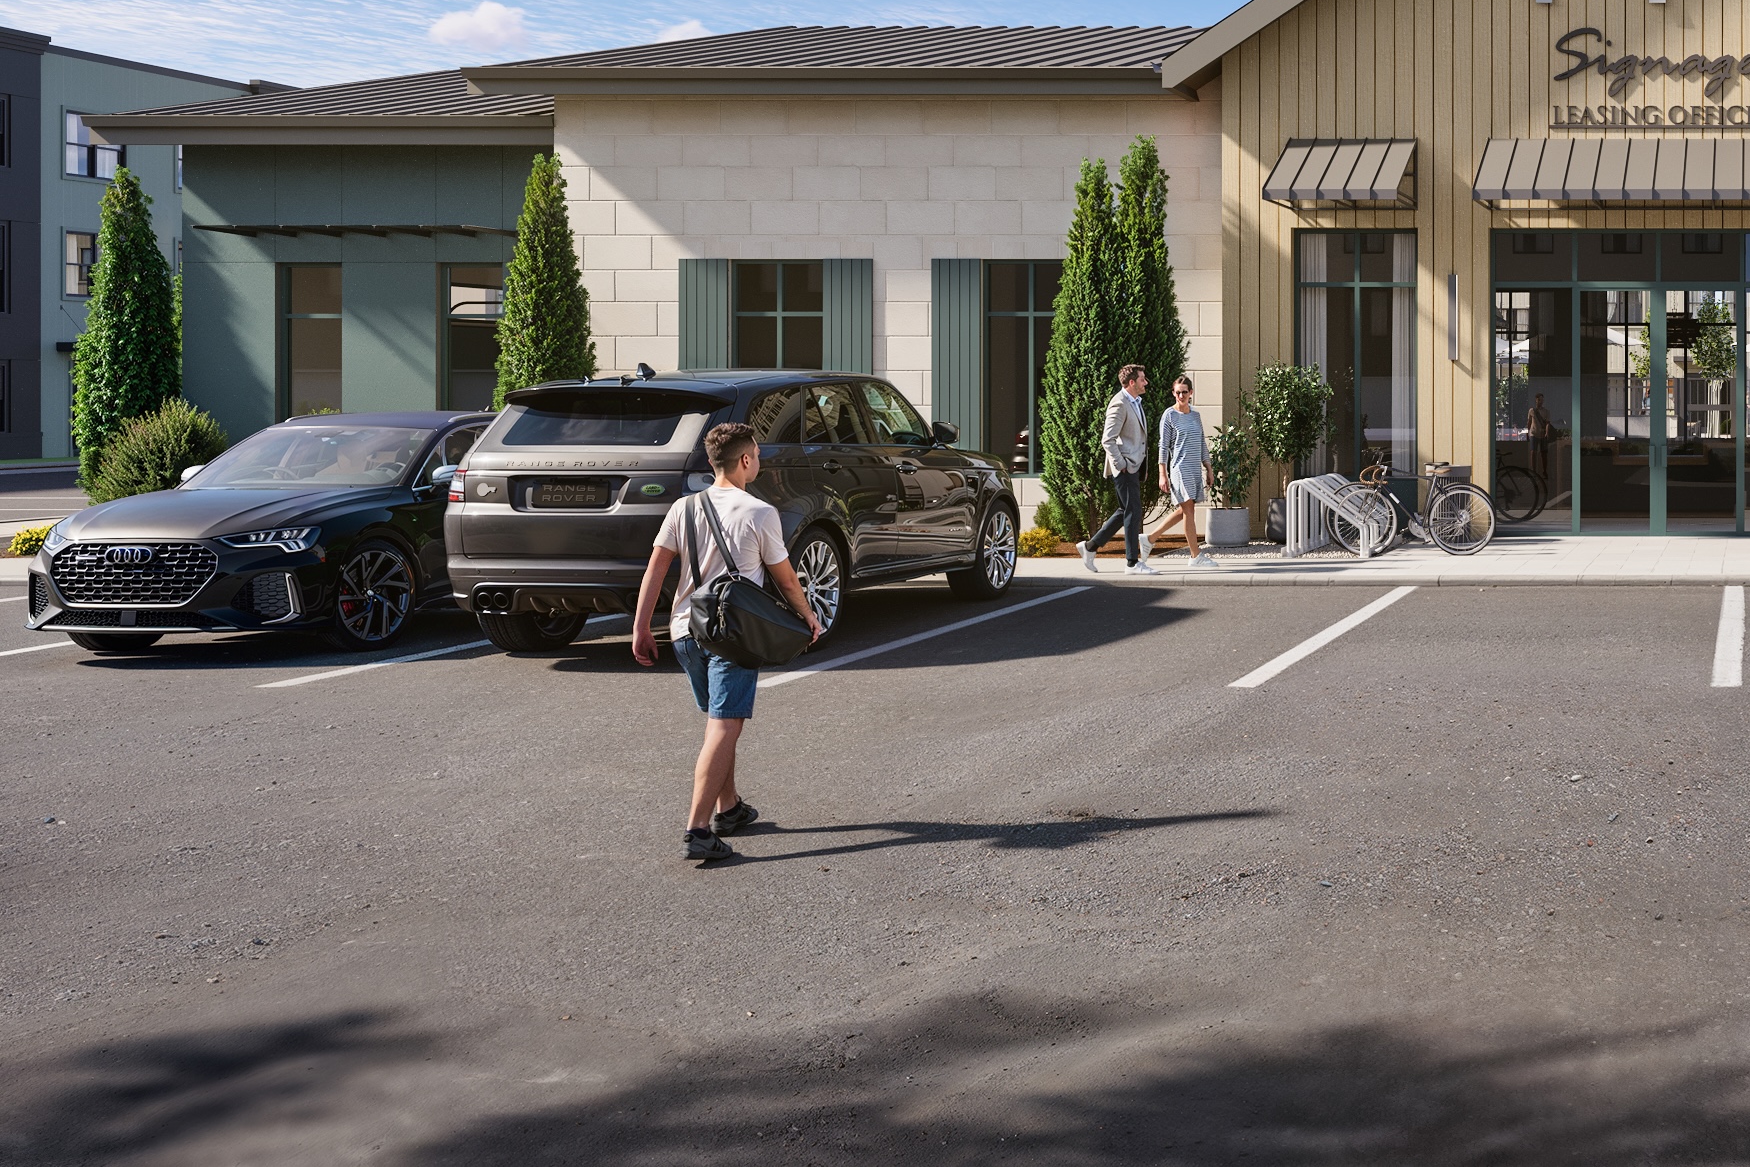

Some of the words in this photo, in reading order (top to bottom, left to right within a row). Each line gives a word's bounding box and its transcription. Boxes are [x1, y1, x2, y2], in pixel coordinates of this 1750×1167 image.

[1553, 105, 1660, 125] LEASING
[542, 484, 596, 492] RANGE
[542, 494, 596, 502] ROVER
